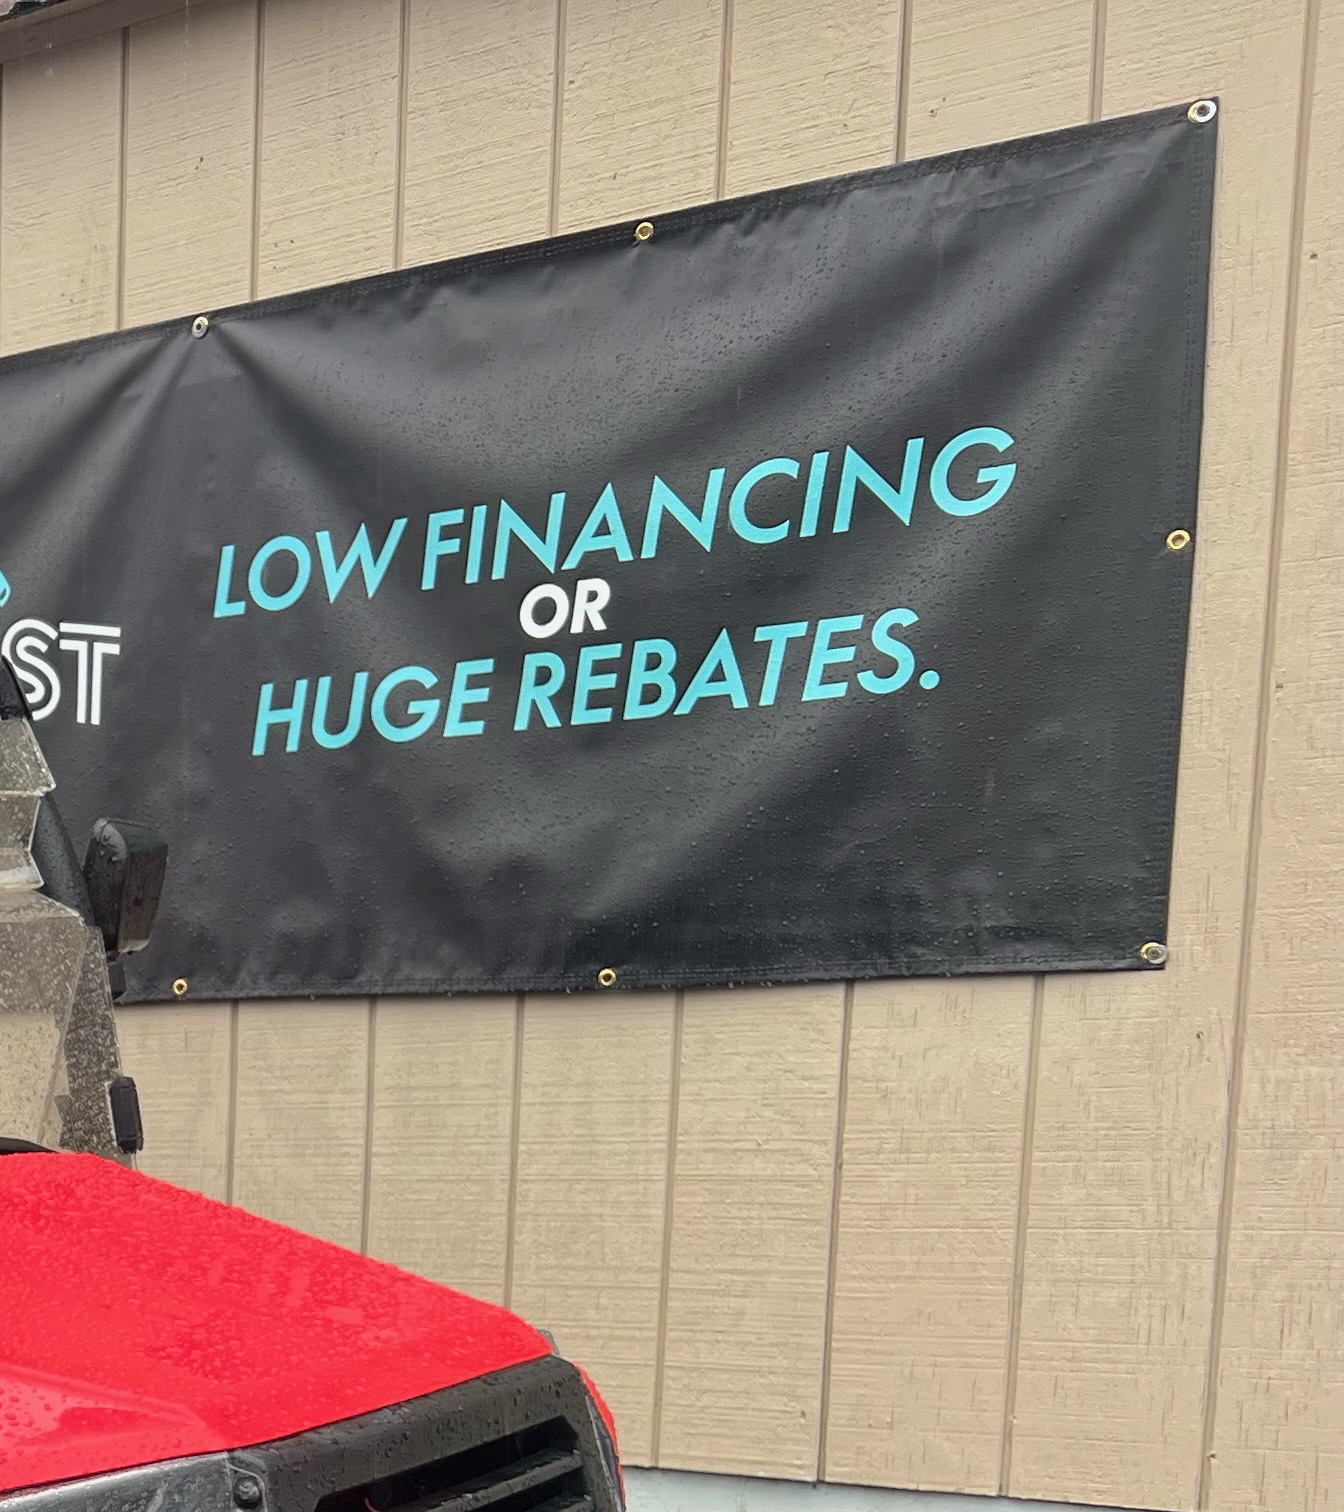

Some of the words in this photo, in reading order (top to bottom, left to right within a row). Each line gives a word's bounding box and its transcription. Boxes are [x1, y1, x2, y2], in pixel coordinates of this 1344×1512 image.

[215, 517, 408, 617] LOW
[421, 426, 1018, 591] FINANCING
[253, 657, 495, 756] HUGE
[514, 607, 941, 732] REBATES.
[519, 577, 611, 639] OR
